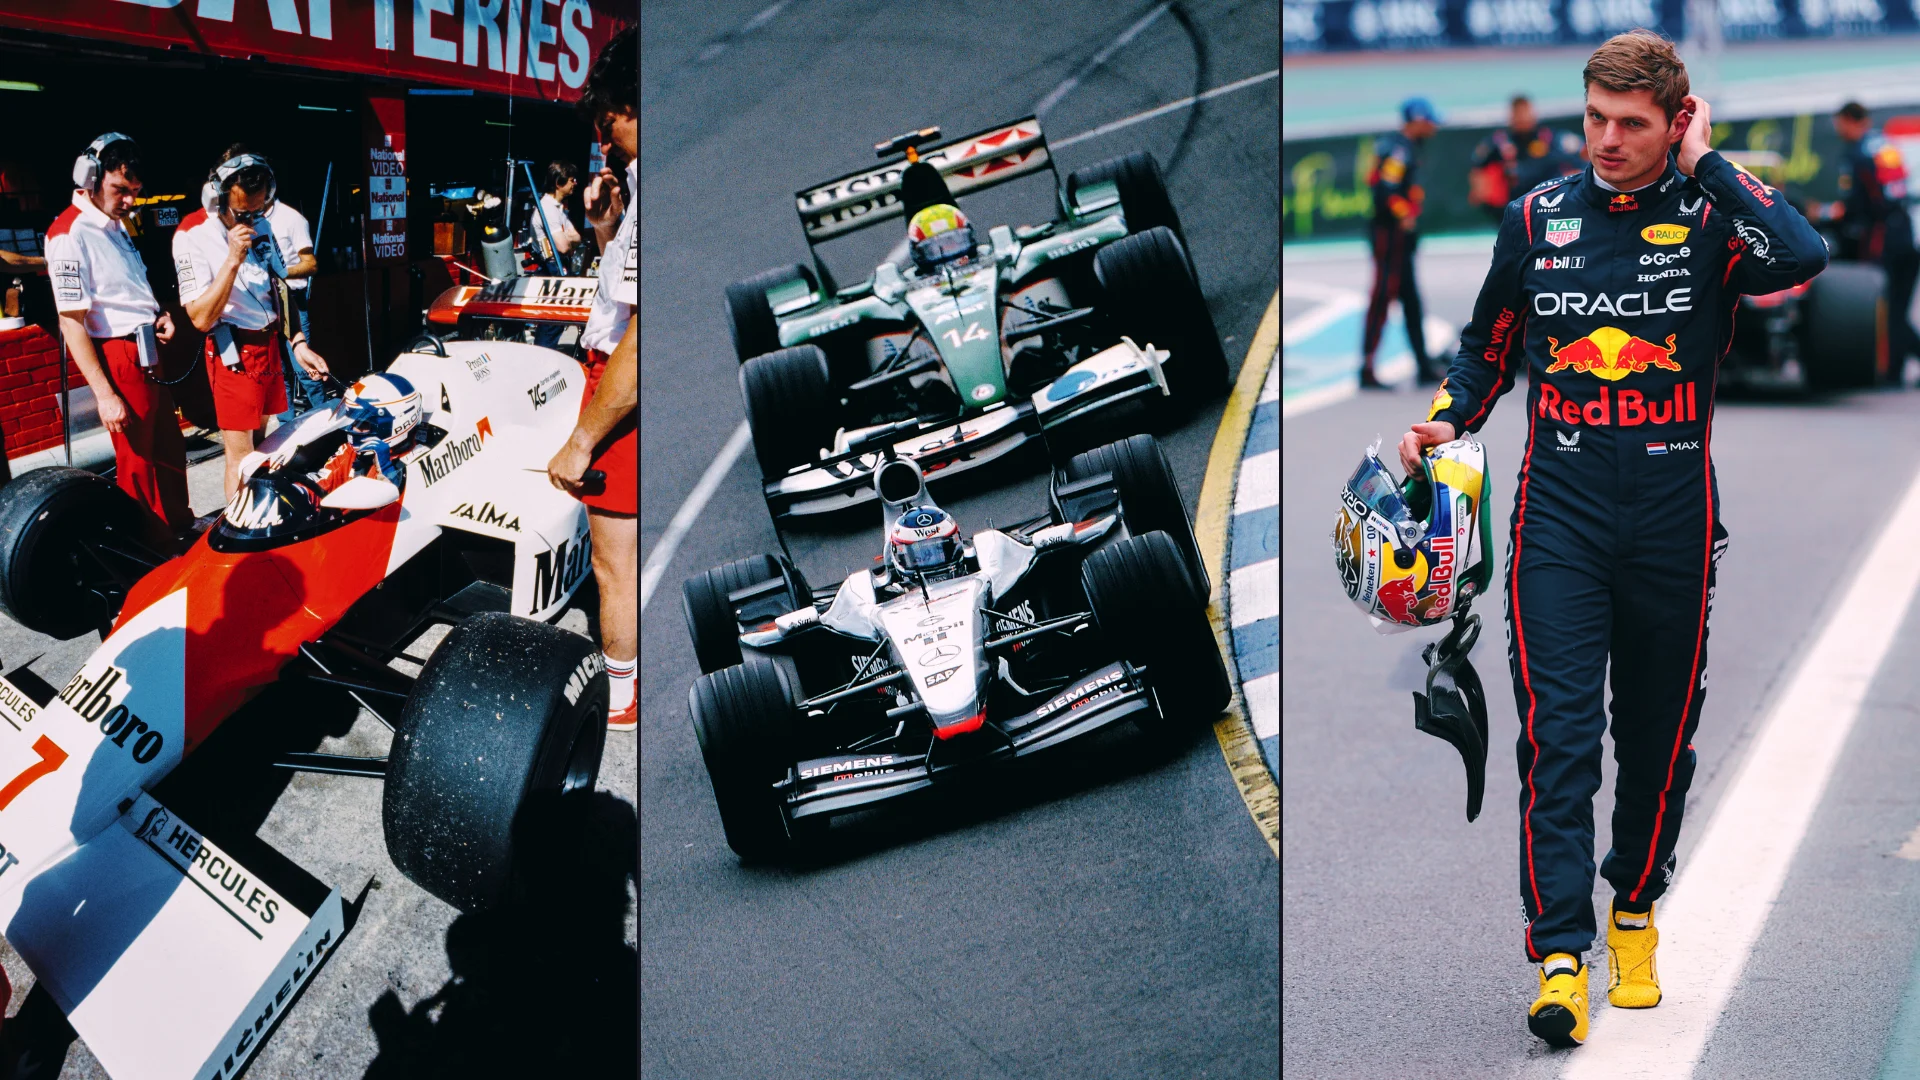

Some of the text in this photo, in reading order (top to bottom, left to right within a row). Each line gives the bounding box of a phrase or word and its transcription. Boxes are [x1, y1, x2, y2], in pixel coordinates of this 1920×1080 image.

[370, 148, 405, 161] National
[372, 162, 405, 175] VIDEO
[371, 192, 404, 203] National
[1735, 173, 1757, 192] Red
[1751, 188, 1775, 208] Bull
[157, 209, 178, 220] Beta
[382, 204, 396, 217] TV
[1608, 203, 1639, 213] Red Bull
[1551, 221, 1579, 231] TAG
[373, 232, 405, 245] National
[1548, 231, 1579, 245] HEUER
[375, 243, 405, 258] VIDEO
[1535, 257, 1569, 271] Mobil
[1637, 268, 1691, 282] HONDA
[1534, 287, 1692, 316] ORACLE
[1490, 307, 1515, 344] WINGS
[942, 322, 991, 348] 14
[466, 357, 484, 371] Prost
[473, 366, 491, 382] BOSS
[527, 383, 547, 411] TAG
[1538, 382, 1696, 426] Red Bull
[1670, 440, 1699, 452] MAX
[418, 433, 482, 489] Marlboro
[914, 526, 940, 539] West
[1362, 563, 1376, 604] Heineken
[1425, 537, 1455, 619] Red Bull
[904, 621, 964, 645] Mobil
[926, 669, 956, 686] SAP
[1036, 670, 1123, 718] SIEMENS
[1071, 682, 1128, 710] mobile
[57, 664, 164, 764] arlboro
[0, 734, 69, 812] 7
[800, 755, 894, 780] SIEMENS
[834, 768, 895, 782] mobile
[167, 825, 280, 925] HERCULES
